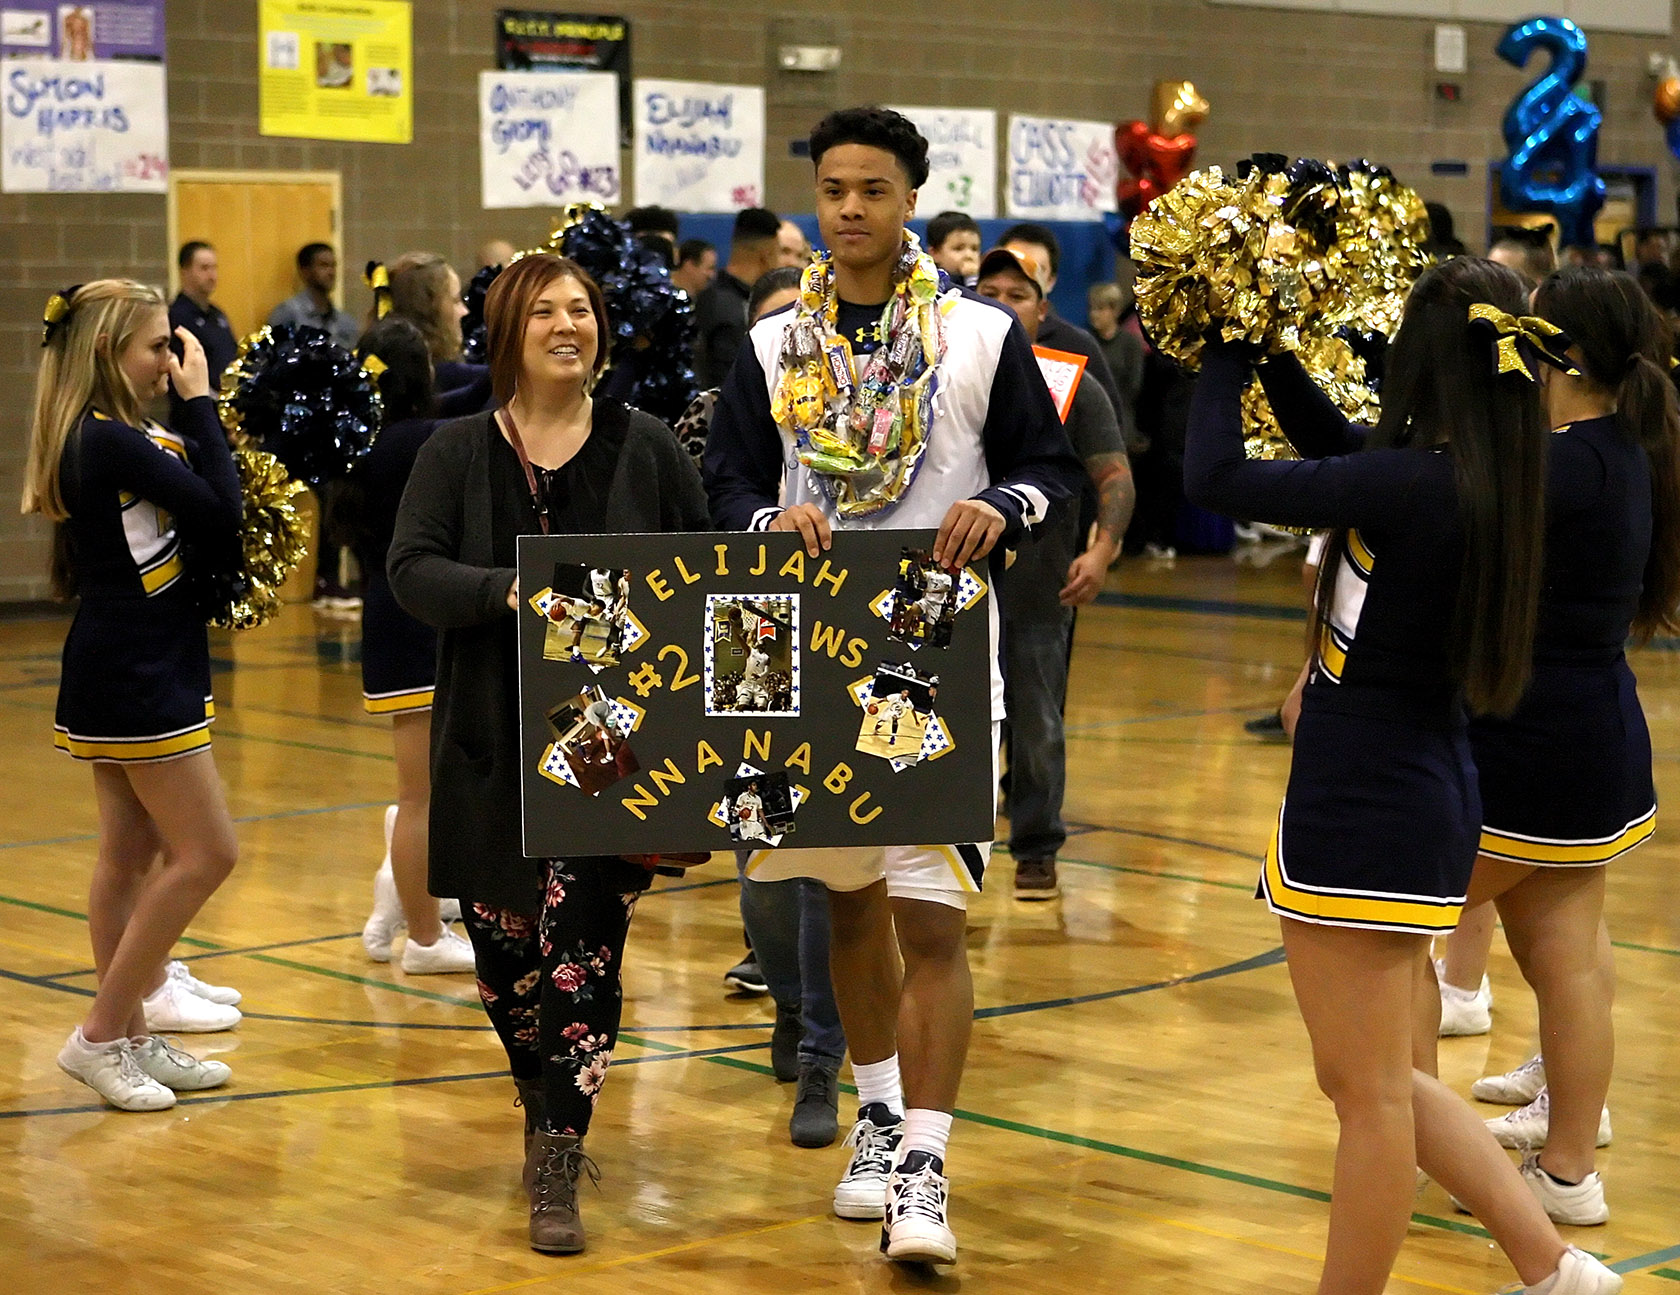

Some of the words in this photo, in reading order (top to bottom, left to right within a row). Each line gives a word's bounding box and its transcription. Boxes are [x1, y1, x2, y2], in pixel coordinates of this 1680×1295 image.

[834, 356, 849, 388] CRUNCH
[645, 544, 849, 602] ELIJAH
[628, 644, 702, 698] #2
[809, 620, 869, 668] WS
[621, 728, 884, 825] NNANABU
